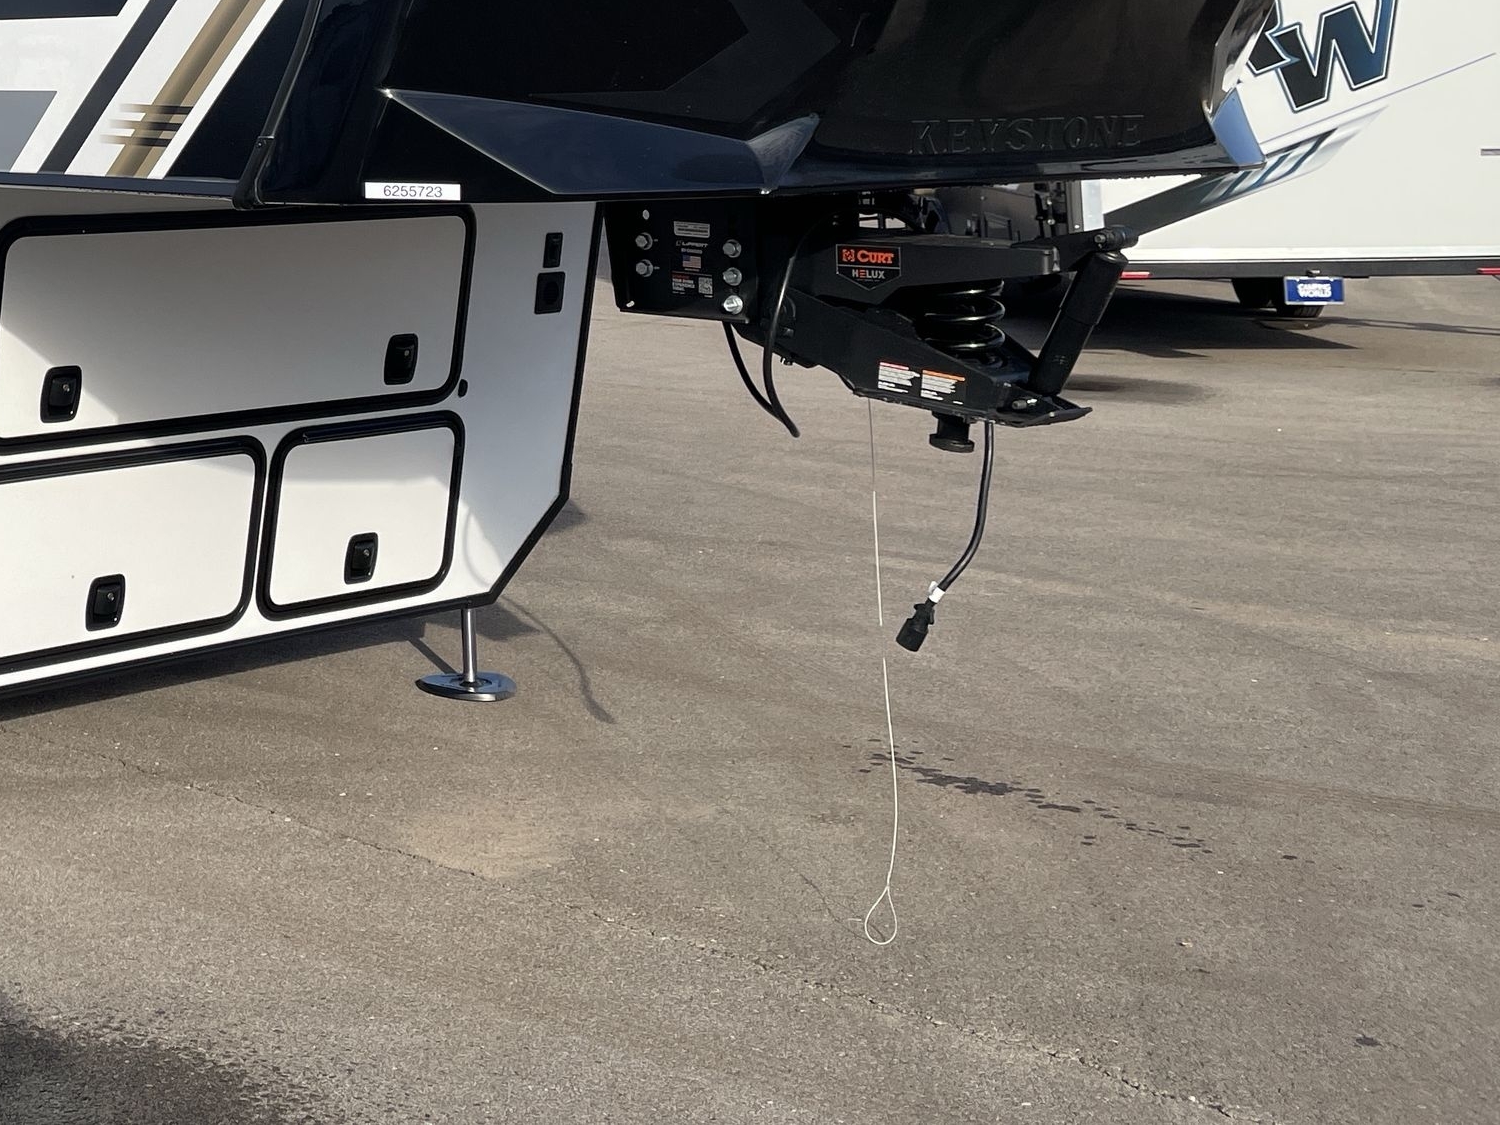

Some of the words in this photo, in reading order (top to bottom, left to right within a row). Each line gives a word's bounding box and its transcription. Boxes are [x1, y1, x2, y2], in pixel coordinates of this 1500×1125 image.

[907, 114, 1146, 155] KEYSTONE
[383, 184, 443, 198] 6255723
[856, 249, 895, 264] CURT
[851, 268, 886, 279] HELUX
